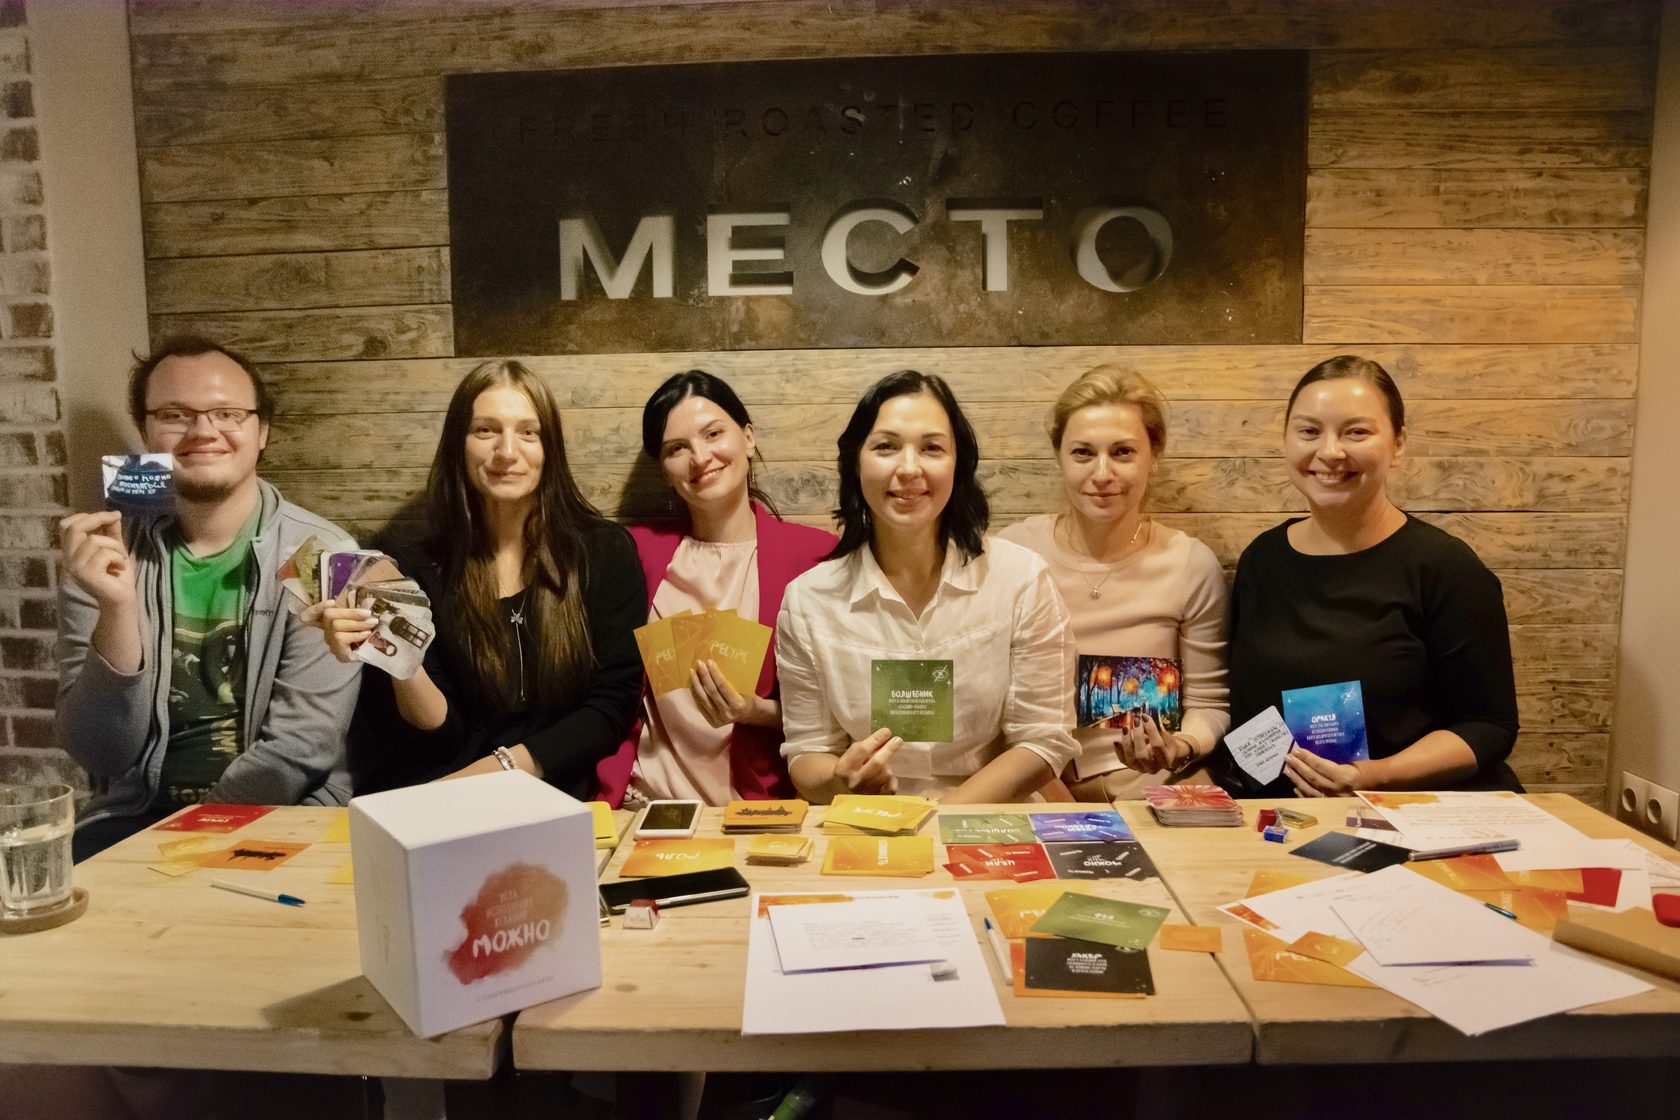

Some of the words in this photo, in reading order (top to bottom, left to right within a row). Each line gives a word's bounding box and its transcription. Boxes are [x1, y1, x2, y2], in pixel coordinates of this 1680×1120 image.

[519, 111, 686, 142] FRESH
[724, 103, 974, 137] ROASTED
[1012, 99, 1228, 130] COFFEE
[559, 204, 1174, 300] МЕСТО
[891, 690, 934, 699] ВОЛШЕБНИК
[472, 919, 551, 959] МОЖНО
